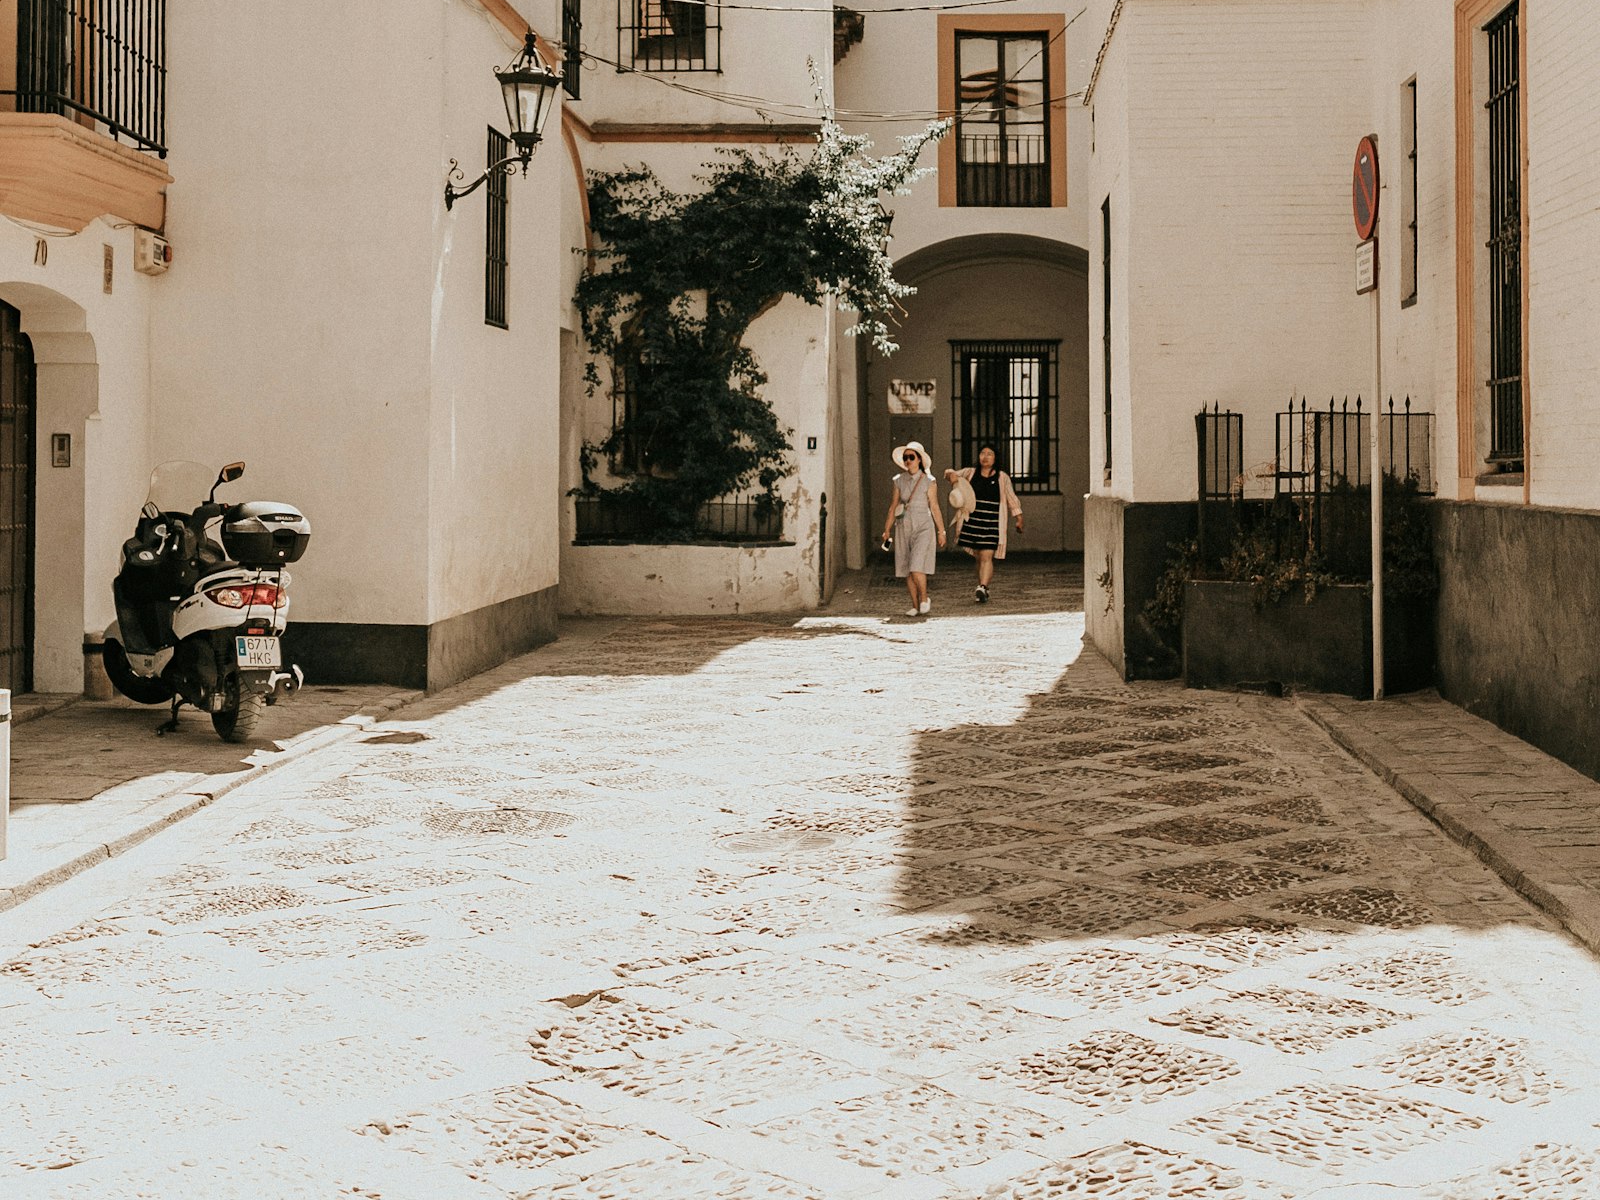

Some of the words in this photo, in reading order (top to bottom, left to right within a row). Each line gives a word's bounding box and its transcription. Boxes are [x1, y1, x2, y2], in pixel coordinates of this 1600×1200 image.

[34, 239, 48, 266] 10
[890, 382, 934, 396] UIMP
[247, 638, 276, 650] 6717
[249, 652, 272, 665] HKG
